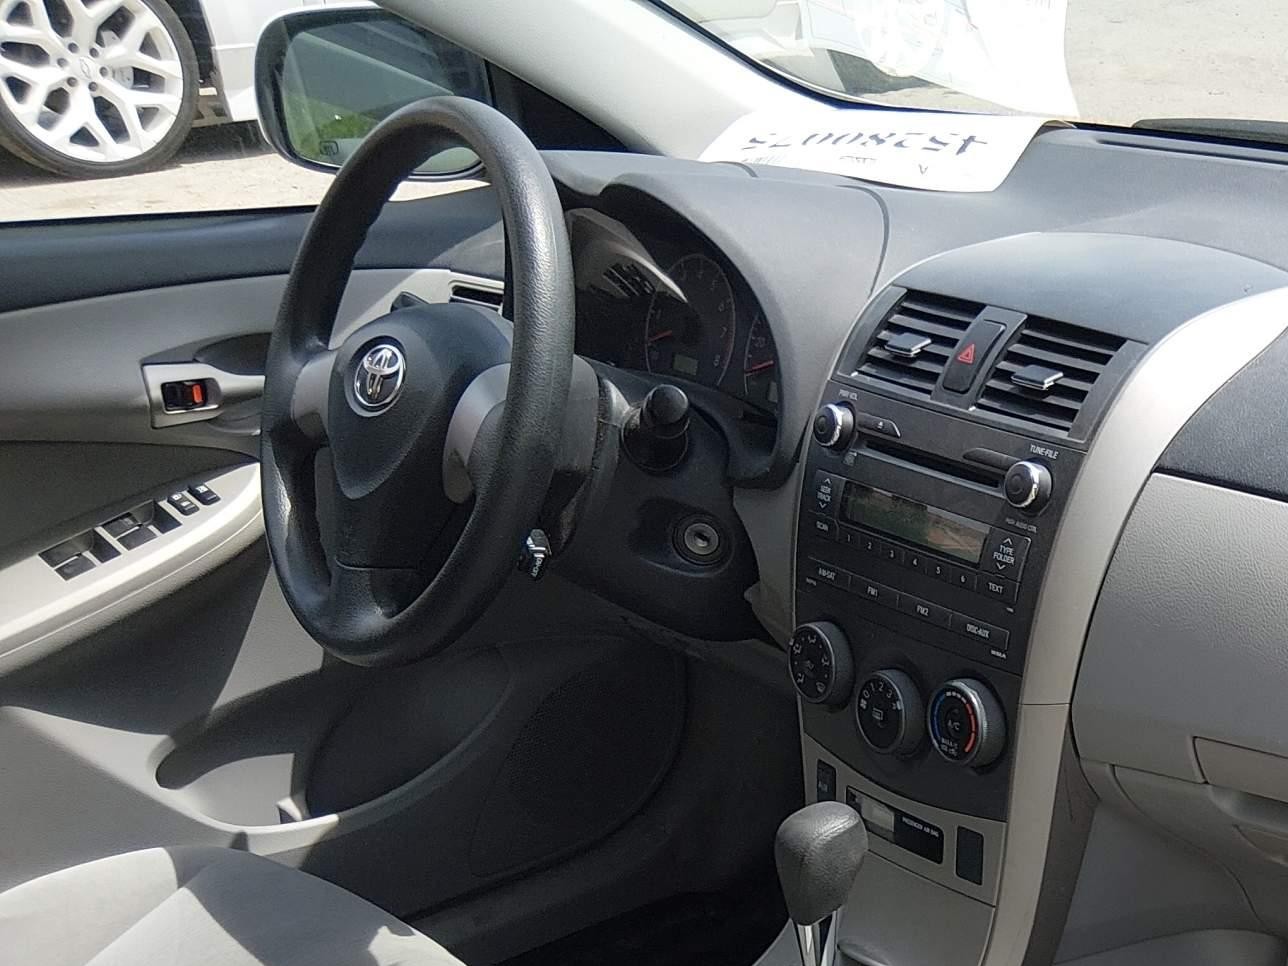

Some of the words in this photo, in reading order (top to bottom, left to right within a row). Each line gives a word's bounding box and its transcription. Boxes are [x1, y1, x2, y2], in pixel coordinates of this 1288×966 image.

[999, 544, 1015, 557] TYPE
[993, 552, 1015, 566] FOLDER
[988, 582, 1004, 594] TEXT
